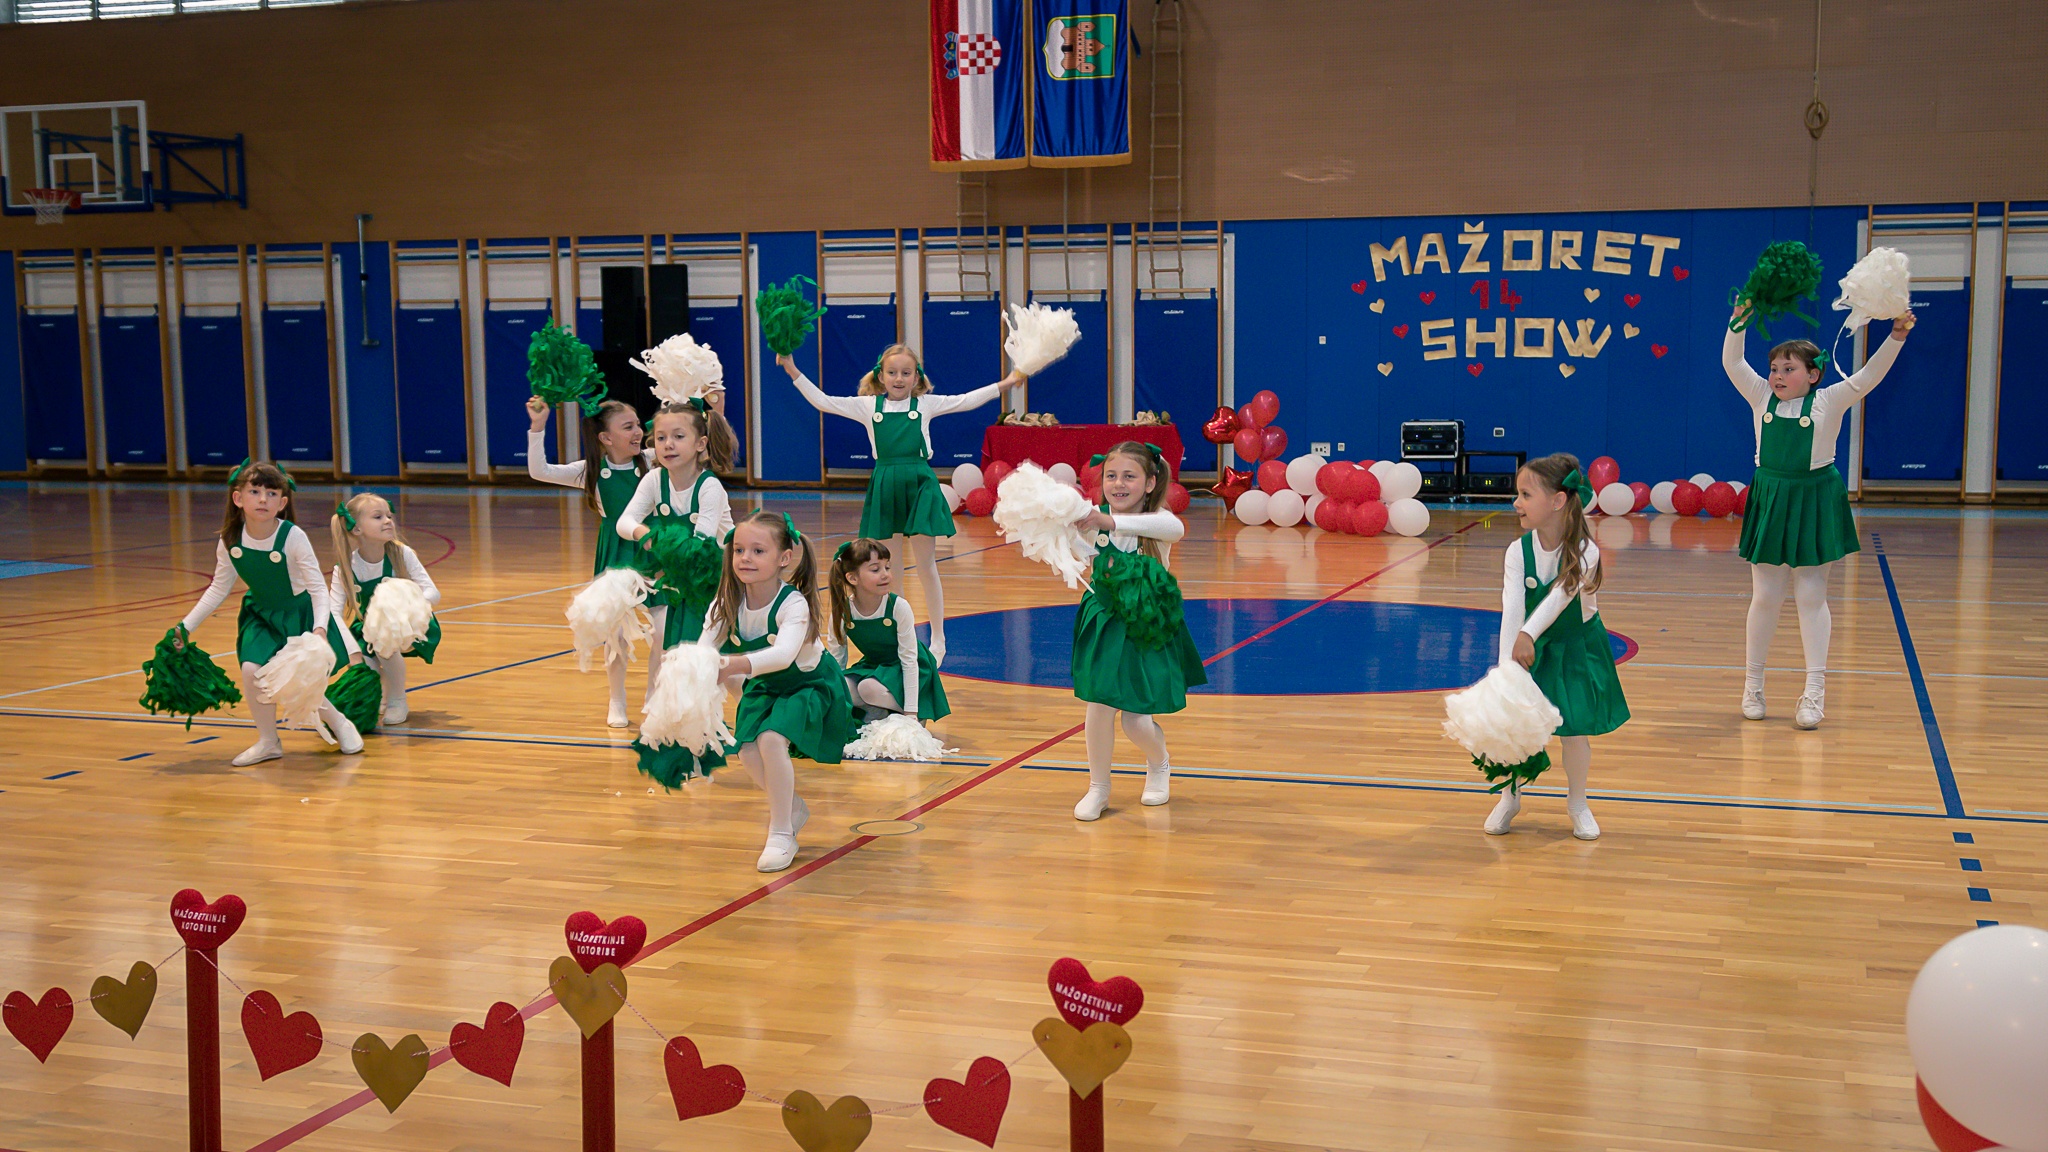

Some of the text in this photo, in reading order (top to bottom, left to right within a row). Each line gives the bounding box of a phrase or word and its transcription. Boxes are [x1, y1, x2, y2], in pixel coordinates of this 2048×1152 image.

[1369, 221, 1680, 282] MAŽORET
[1421, 317, 1612, 361] SHOW
[174, 909, 226, 922] MAŽORETKINJE
[181, 921, 217, 933] KOTORIBE
[569, 931, 625, 945] MAŽORETKINJE
[1055, 982, 1123, 1013] MAŽORETKINJE
[1063, 1000, 1111, 1022] KOTORIBE
